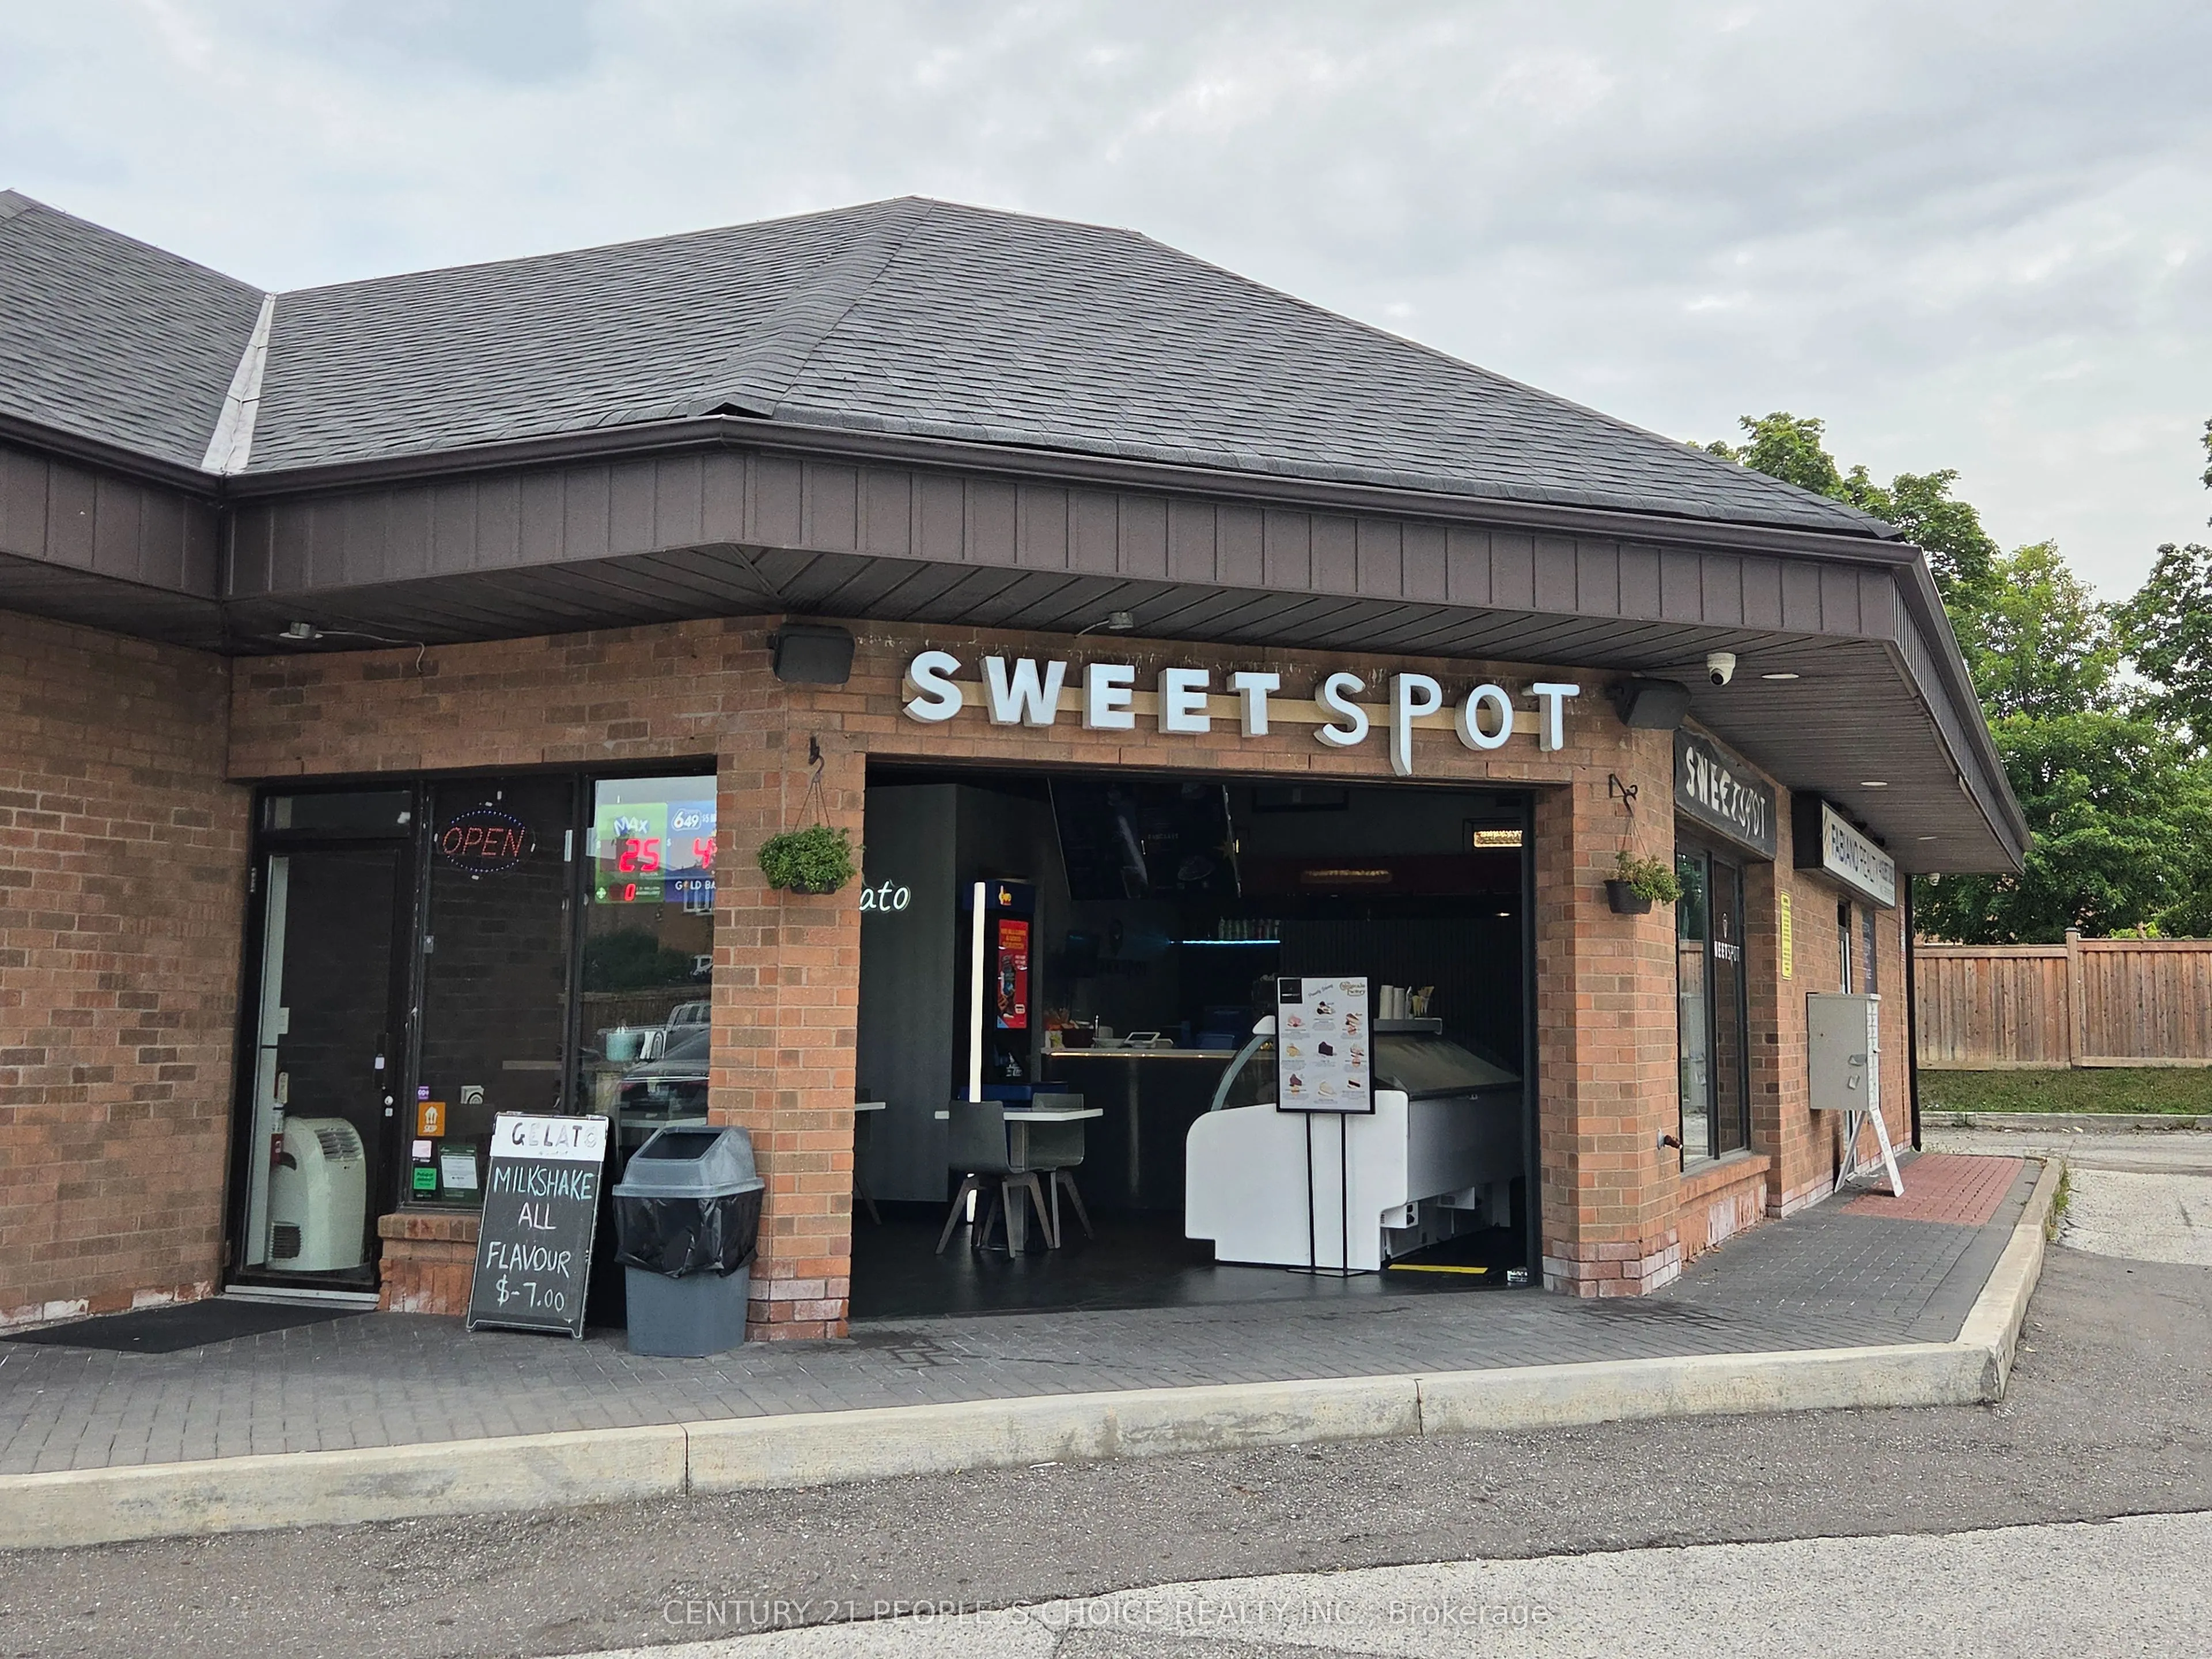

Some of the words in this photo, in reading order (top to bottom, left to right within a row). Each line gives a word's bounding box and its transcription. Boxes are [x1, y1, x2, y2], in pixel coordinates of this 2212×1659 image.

[902, 651, 1280, 738] SWEET
[1313, 672, 1580, 776] SPOT
[614, 816, 648, 836] MAX
[673, 811, 699, 829] 649
[443, 827, 525, 857] OPEN
[619, 838, 660, 872] 25
[624, 883, 637, 902] 0
[675, 881, 702, 891] GOLD
[859, 881, 909, 911] ato
[512, 1122, 597, 1148] GELATO
[494, 1164, 594, 1201] MILKSHAKE
[518, 1202, 557, 1229] ALL
[486, 1241, 571, 1279] FLAVOUR
